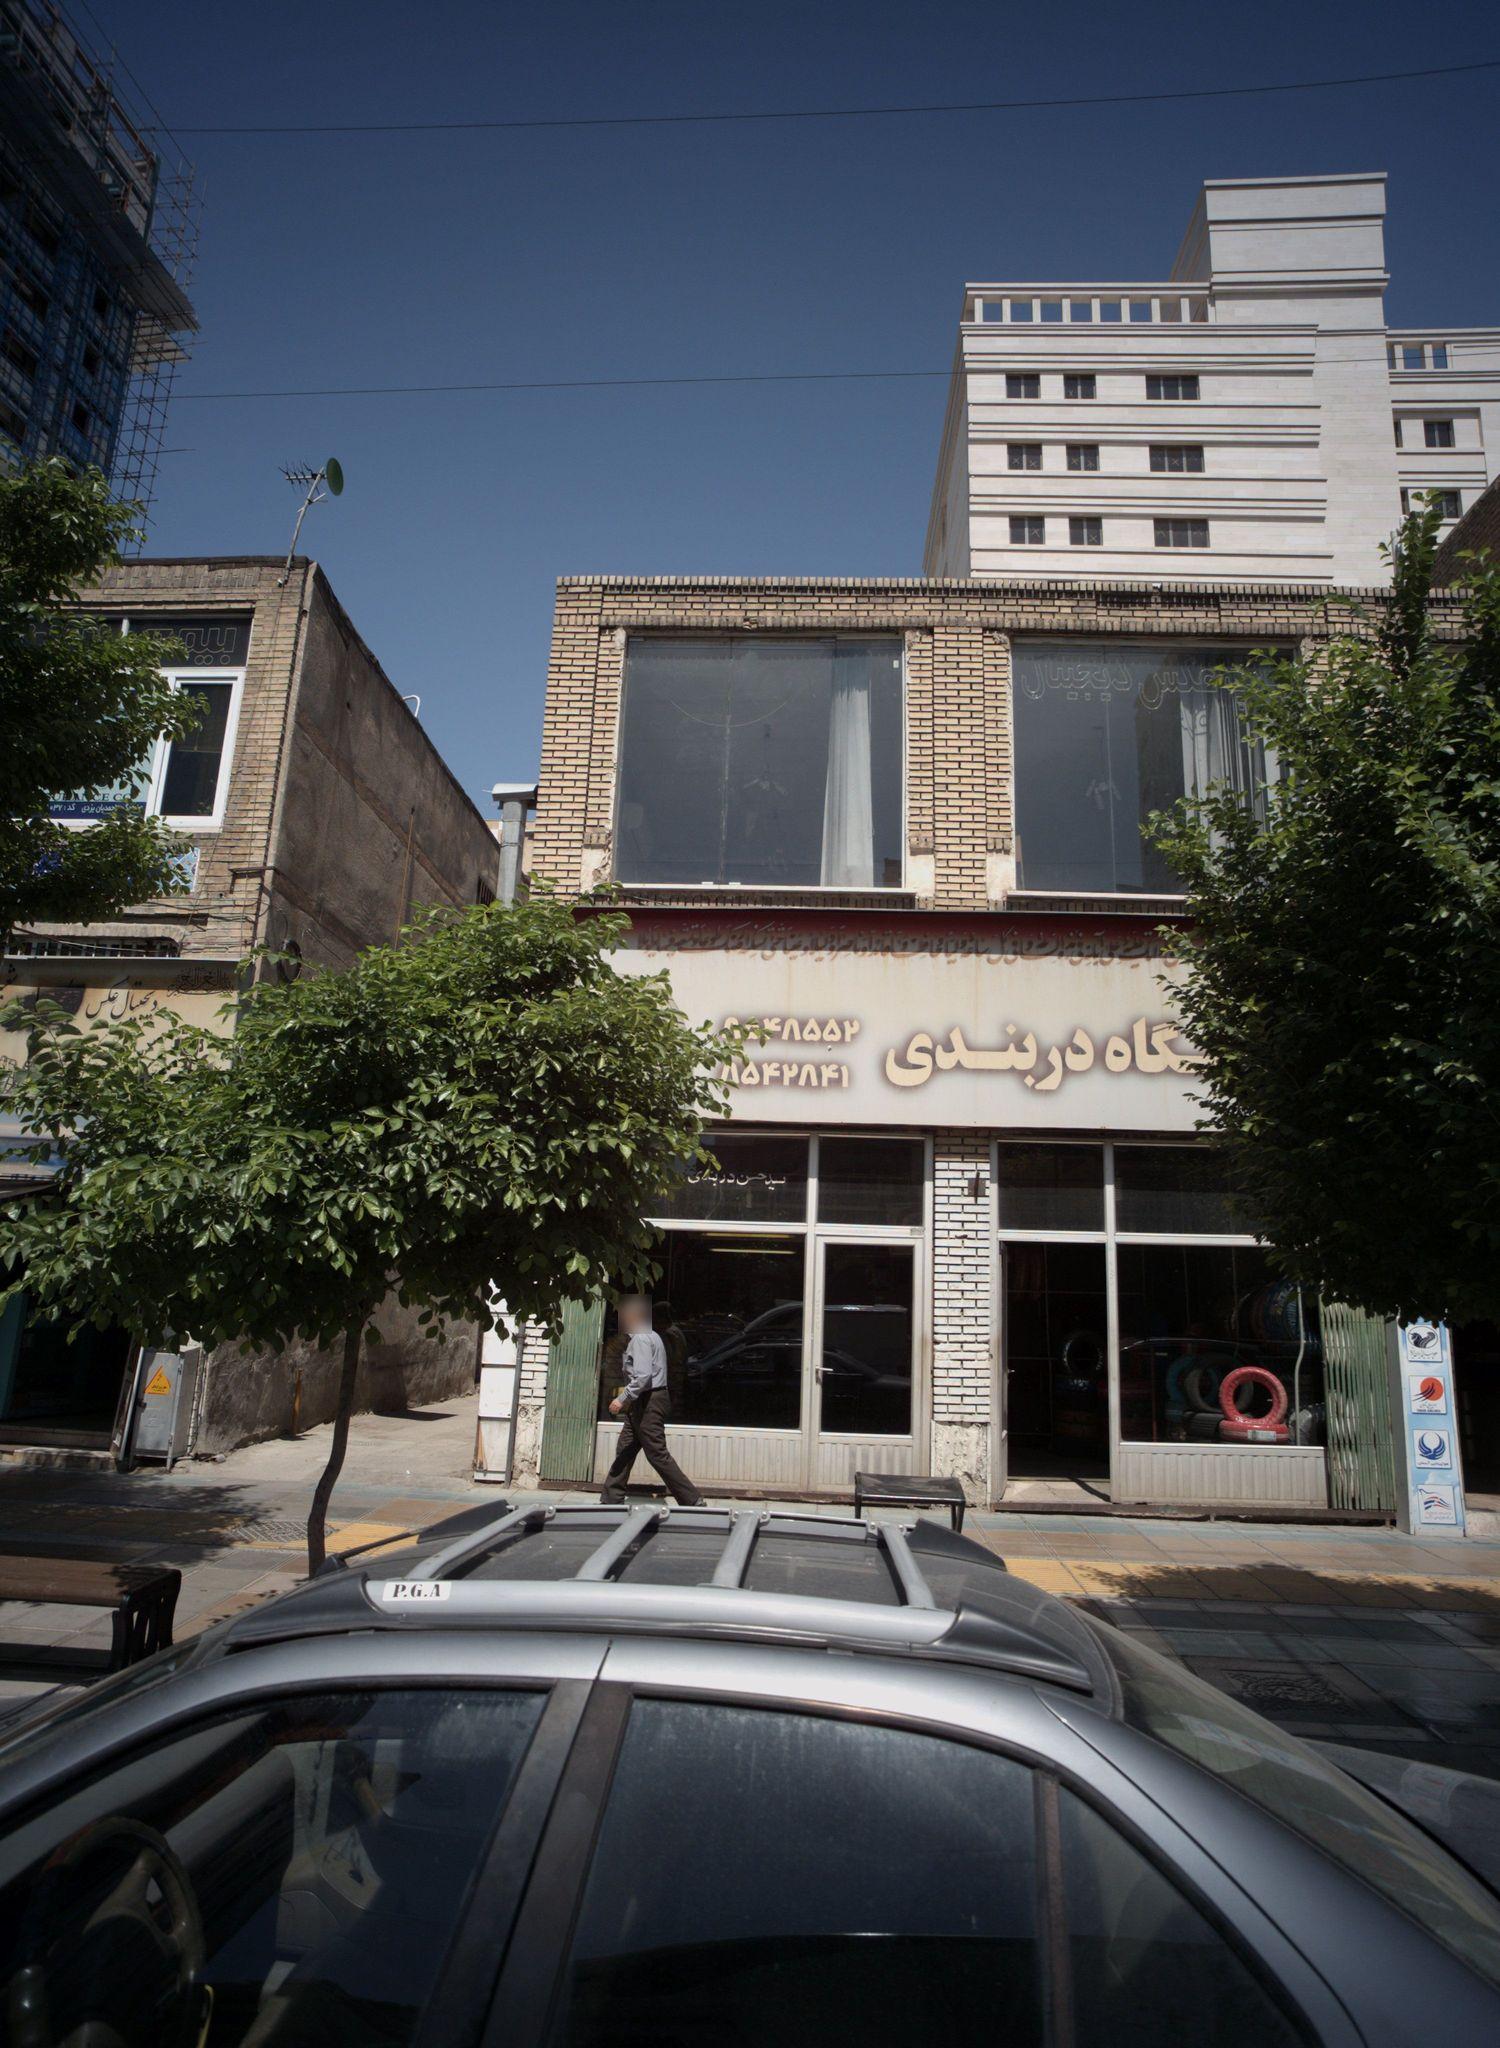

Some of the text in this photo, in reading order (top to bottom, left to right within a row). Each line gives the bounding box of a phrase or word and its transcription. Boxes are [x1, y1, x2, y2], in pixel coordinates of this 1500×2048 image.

[85, 975, 130, 1019] عکس
[885, 1023, 1095, 1090] دربندی
[720, 1062, 849, 1088] ۸۵۴۲۸۴۱
[687, 1171, 787, 1190] سید حسن دربندی
[393, 1584, 441, 1598] P.G.A
